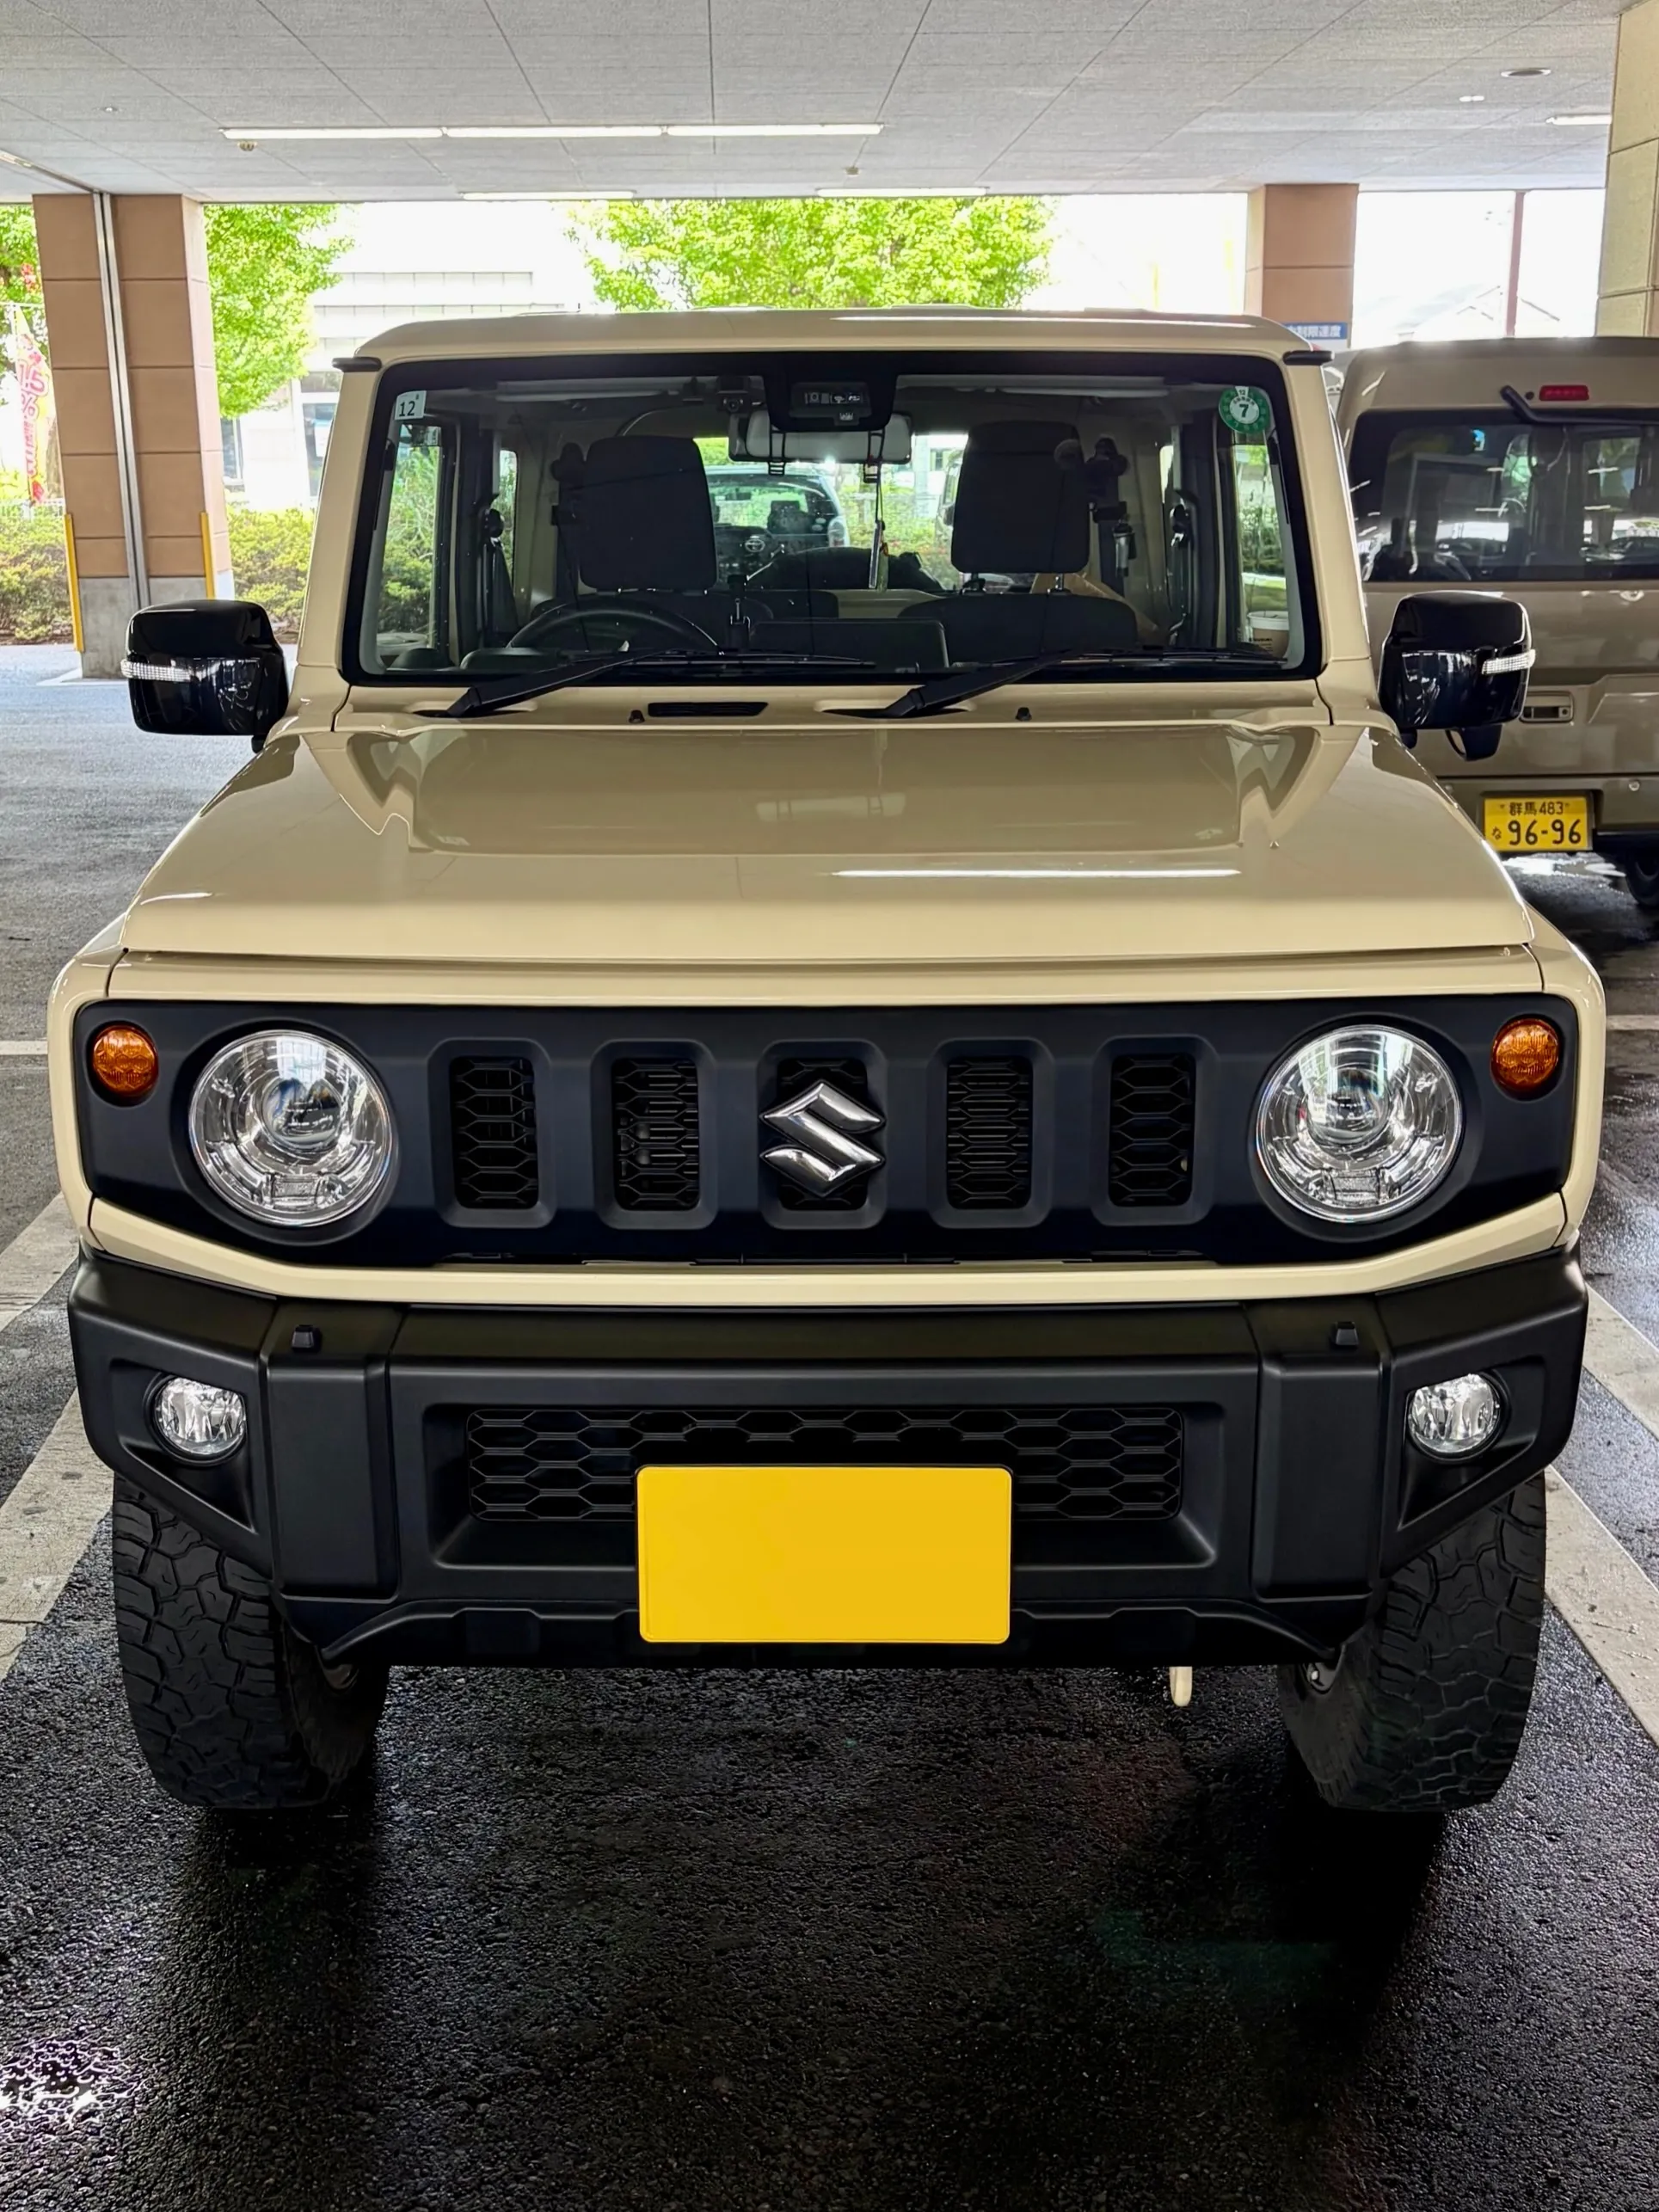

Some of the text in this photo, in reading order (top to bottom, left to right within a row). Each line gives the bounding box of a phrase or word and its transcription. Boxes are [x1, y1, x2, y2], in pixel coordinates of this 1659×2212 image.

[398, 401, 415, 416] 12
[1238, 403, 1249, 418] 7
[1509, 802, 1564, 815] 群馬 483
[1508, 820, 1581, 845] 96-96
